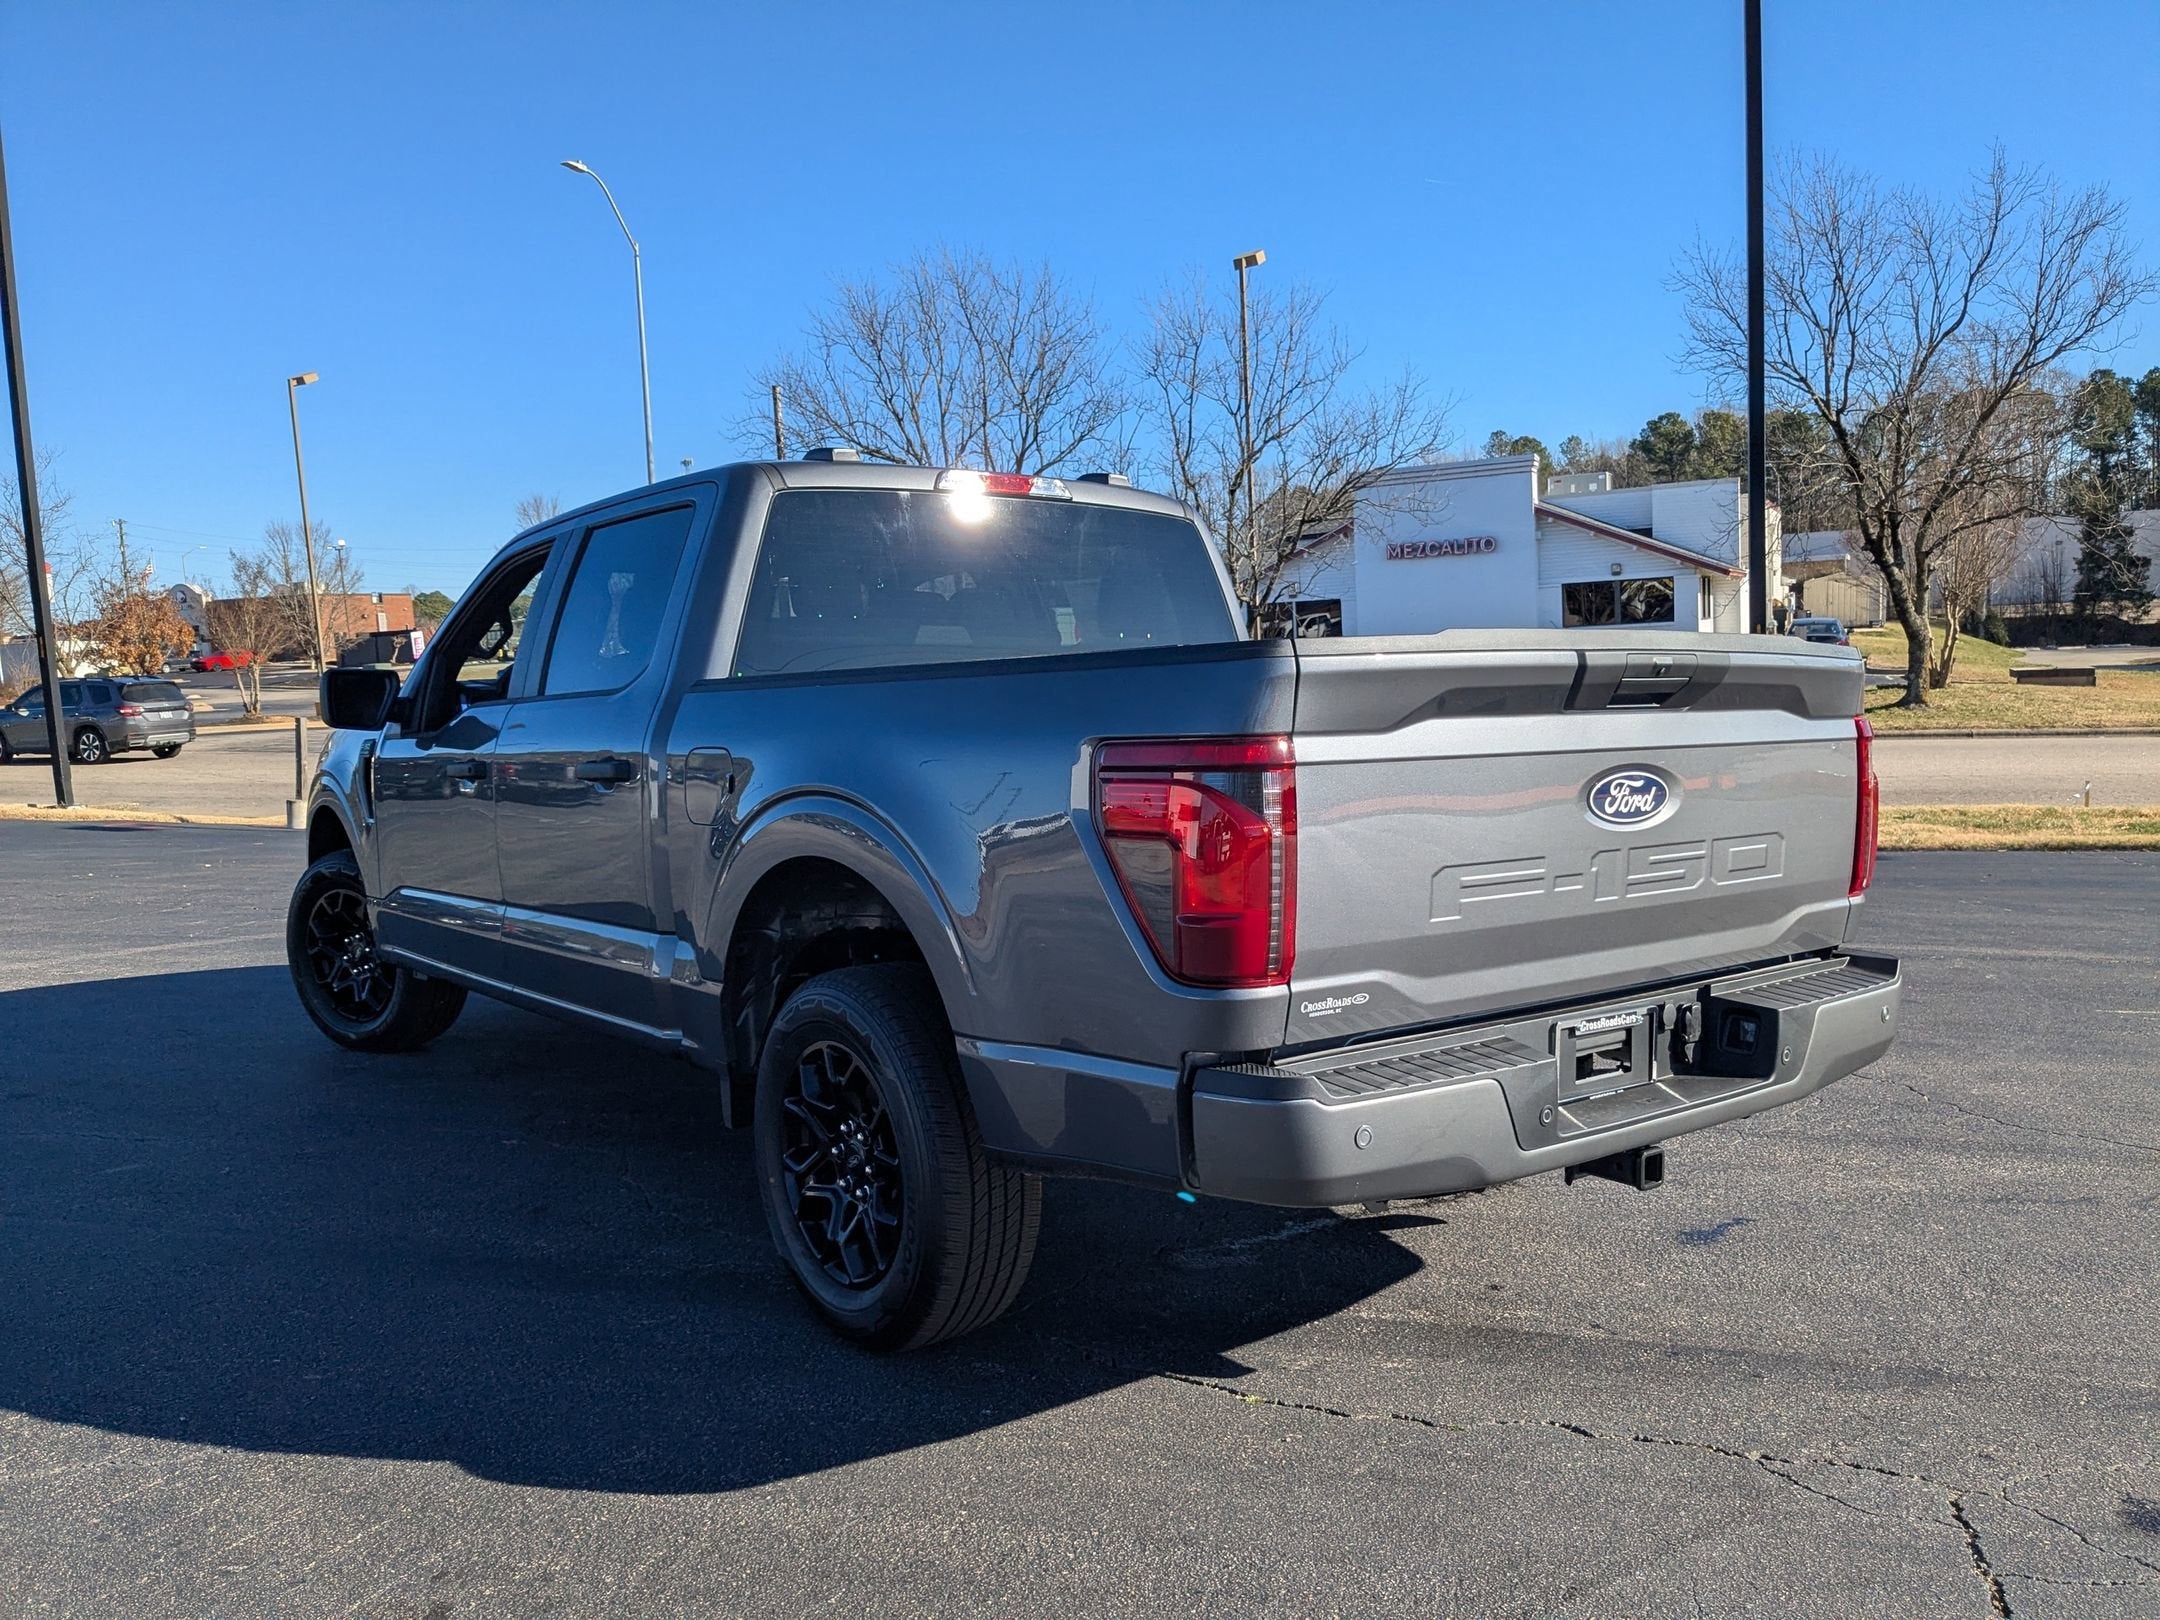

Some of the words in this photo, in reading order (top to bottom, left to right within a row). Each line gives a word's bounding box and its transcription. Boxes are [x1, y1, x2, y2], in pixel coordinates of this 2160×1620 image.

[1386, 536, 1497, 560] MEZCALITO
[1604, 778, 1656, 814] Ford
[1430, 832, 1785, 922] F-150
